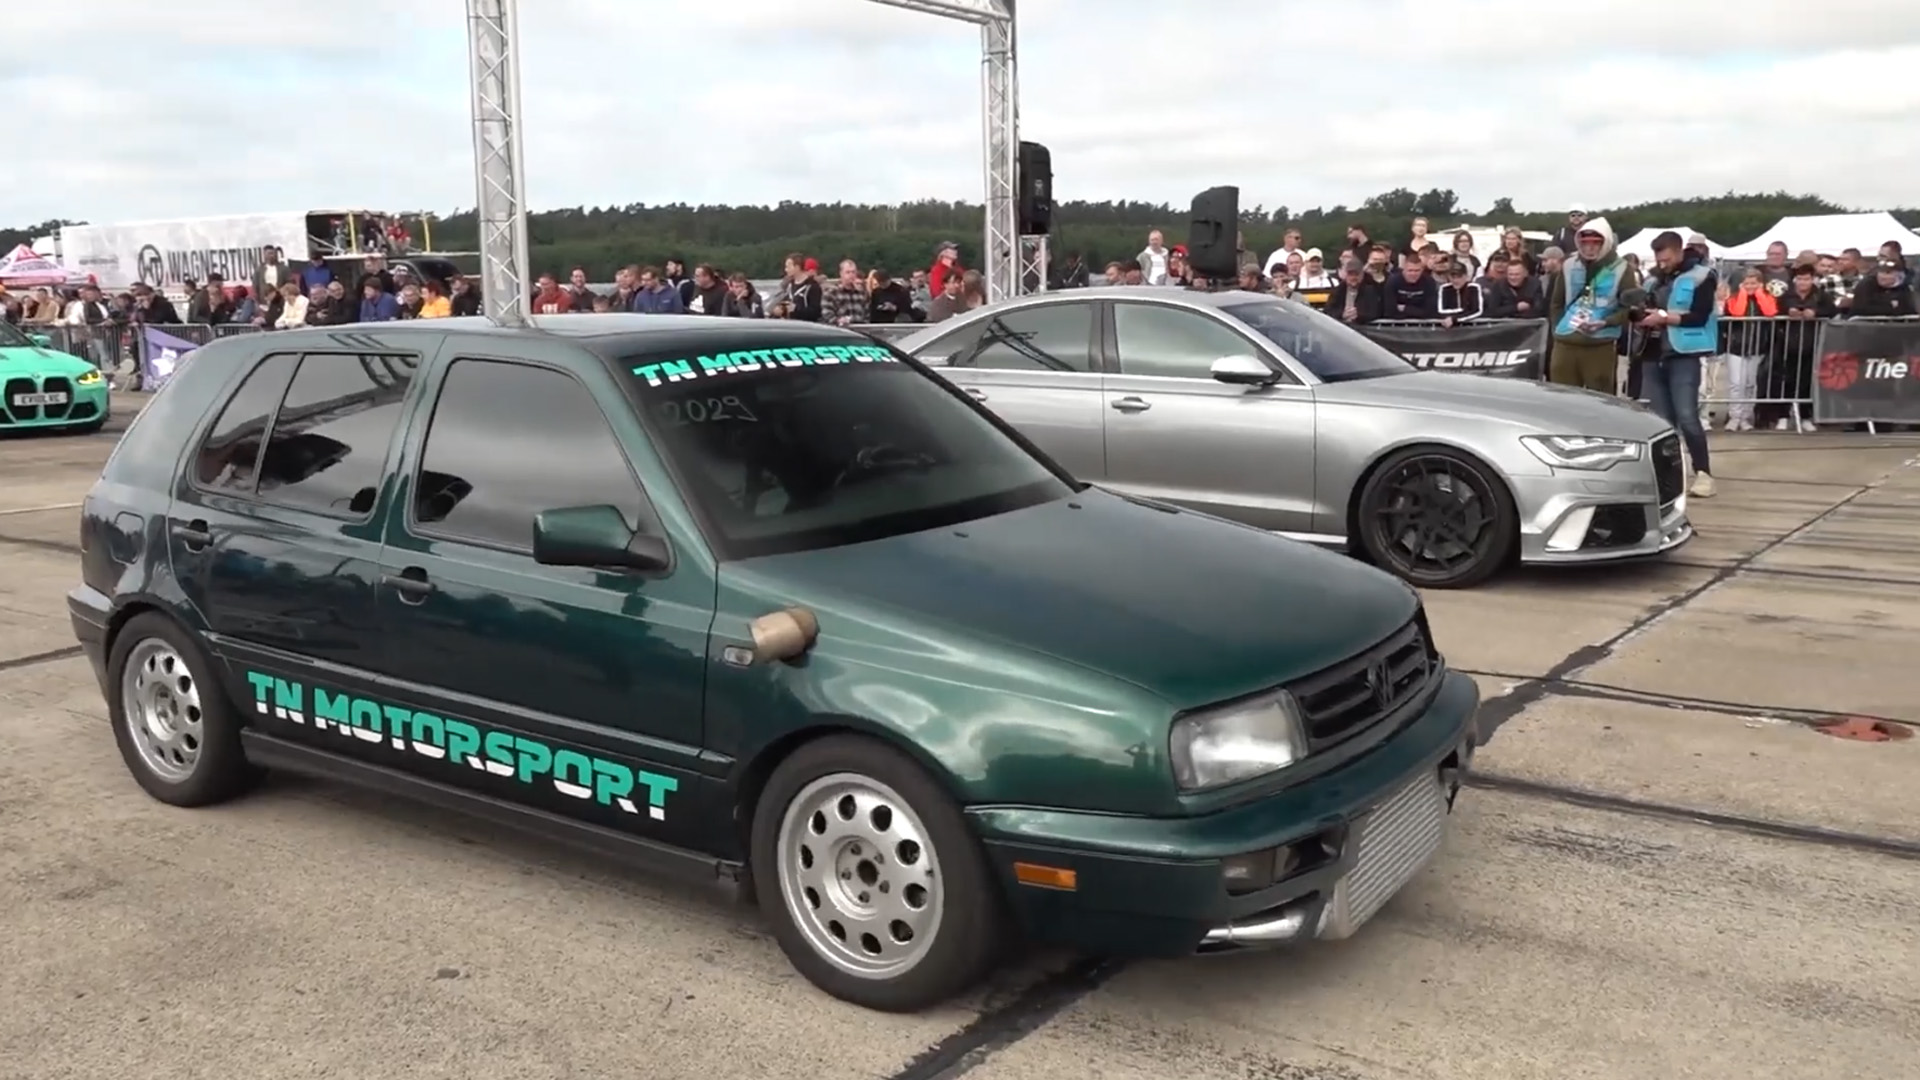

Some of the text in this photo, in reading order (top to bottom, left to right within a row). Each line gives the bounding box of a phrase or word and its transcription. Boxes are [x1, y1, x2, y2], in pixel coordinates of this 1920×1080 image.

[632, 345, 899, 387] TN MOTORSPORT
[1864, 357, 1908, 379] The
[248, 672, 679, 821] TN MOTORSPORT
